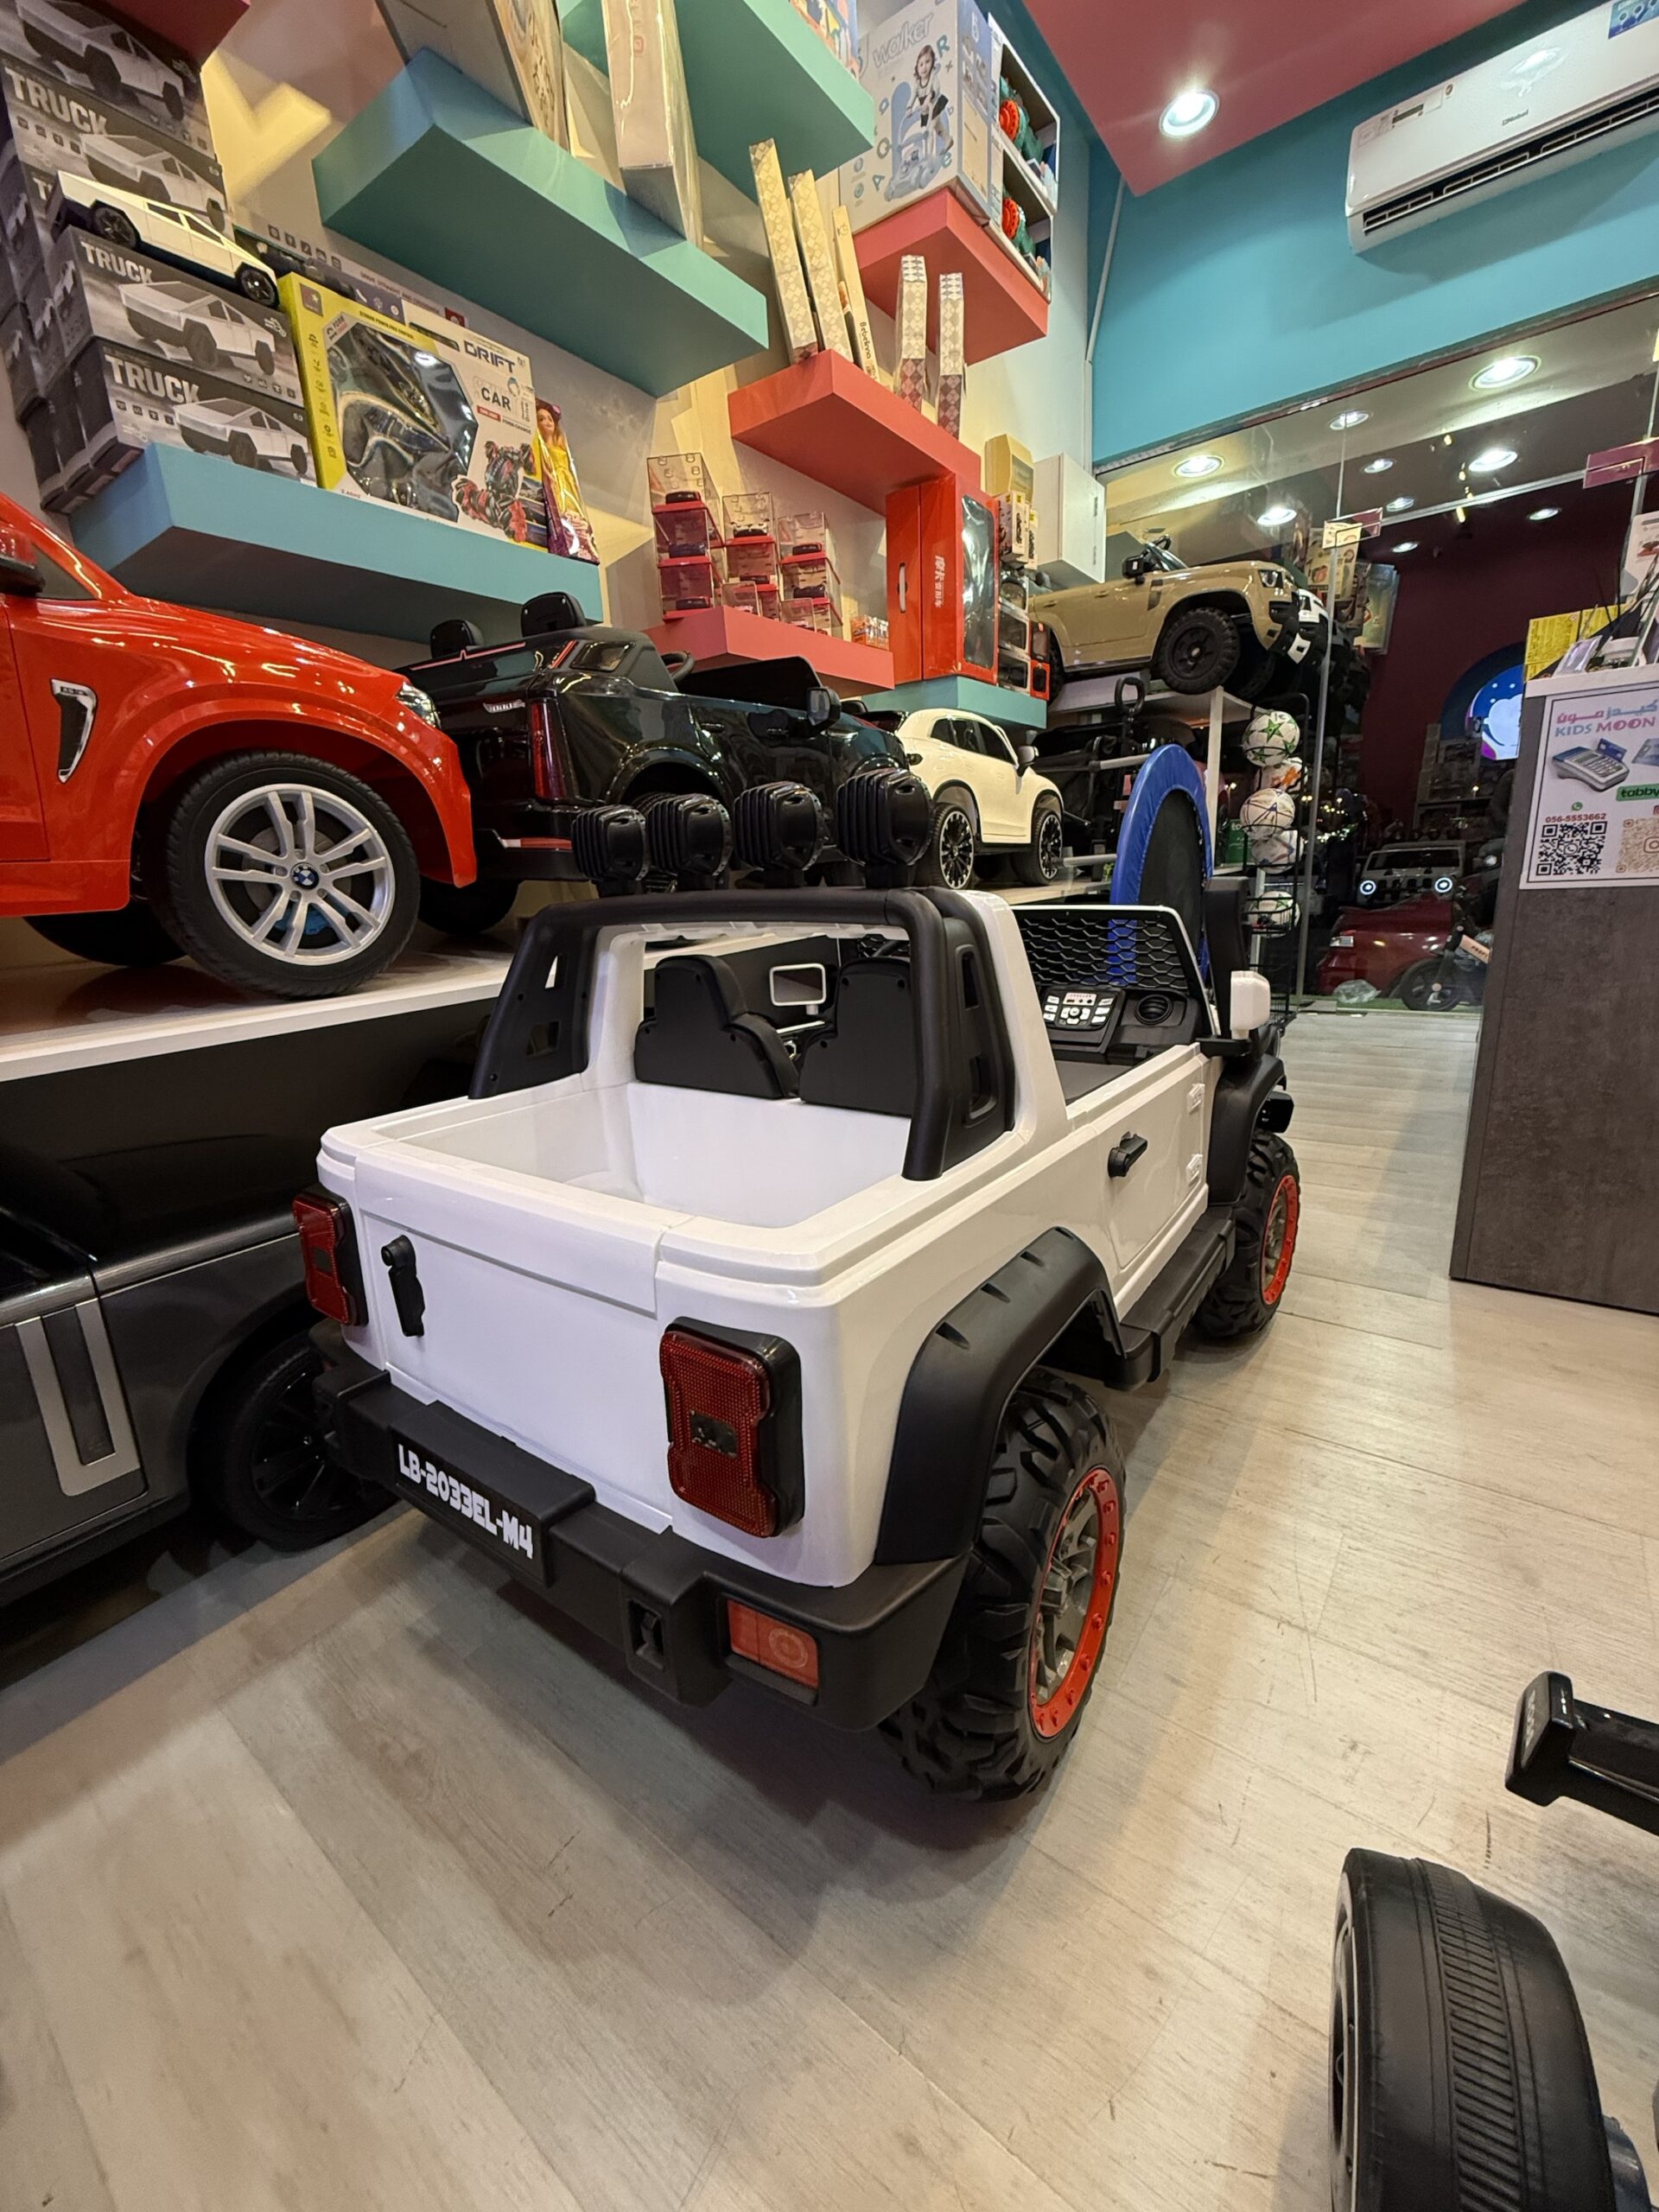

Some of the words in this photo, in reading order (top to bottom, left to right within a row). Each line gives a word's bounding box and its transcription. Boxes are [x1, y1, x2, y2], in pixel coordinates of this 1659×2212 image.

[872, 12, 934, 69] walker
[3, 67, 107, 136] TRUCK
[80, 241, 153, 283] TRUCK
[463, 340, 516, 373] DRIFT
[105, 354, 200, 404] TRUCK
[481, 386, 512, 410] CAR
[1554, 723, 1592, 737] KIDS
[1596, 716, 1656, 733] MOON
[1545, 813, 1606, 823] 056-5553662
[398, 1443, 534, 1560] LB-2033EL-M4
